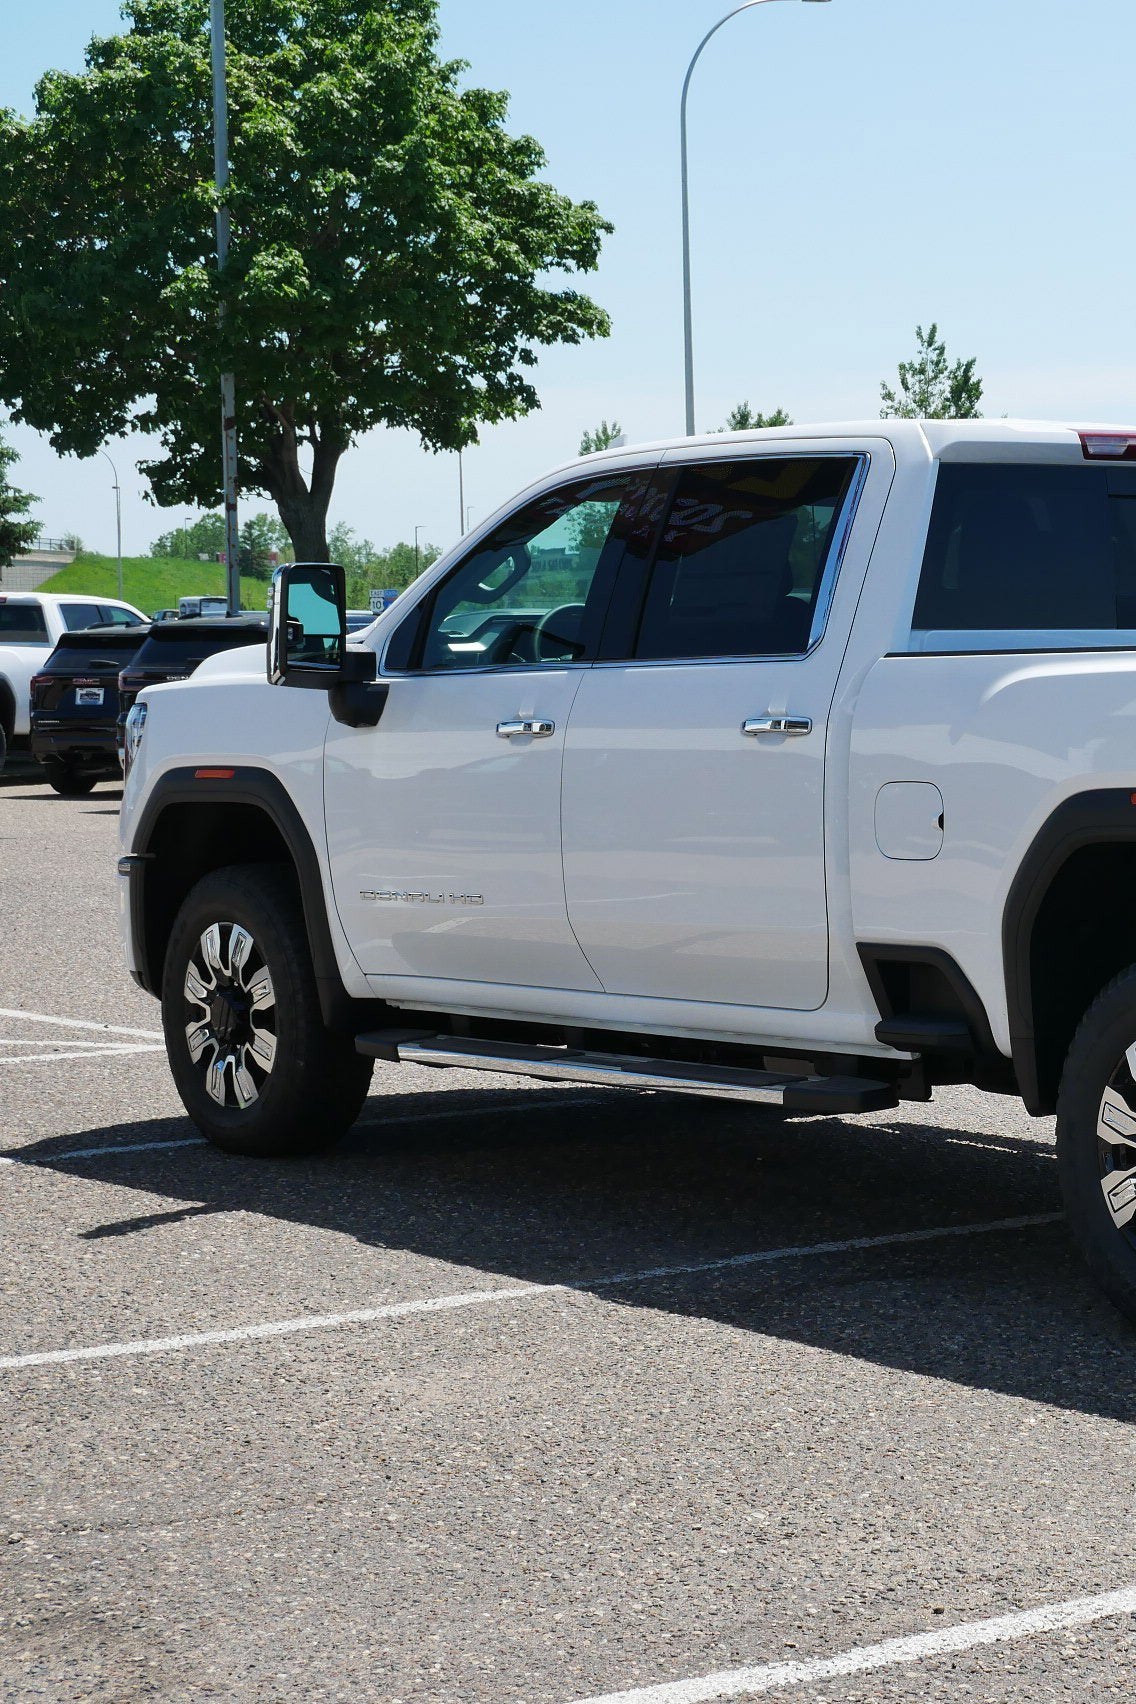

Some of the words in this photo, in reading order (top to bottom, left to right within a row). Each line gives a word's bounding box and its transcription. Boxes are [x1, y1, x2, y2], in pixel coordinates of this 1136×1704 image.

[372, 601, 382, 609] 10
[359, 889, 445, 904] DENALI
[448, 892, 485, 905] HD
